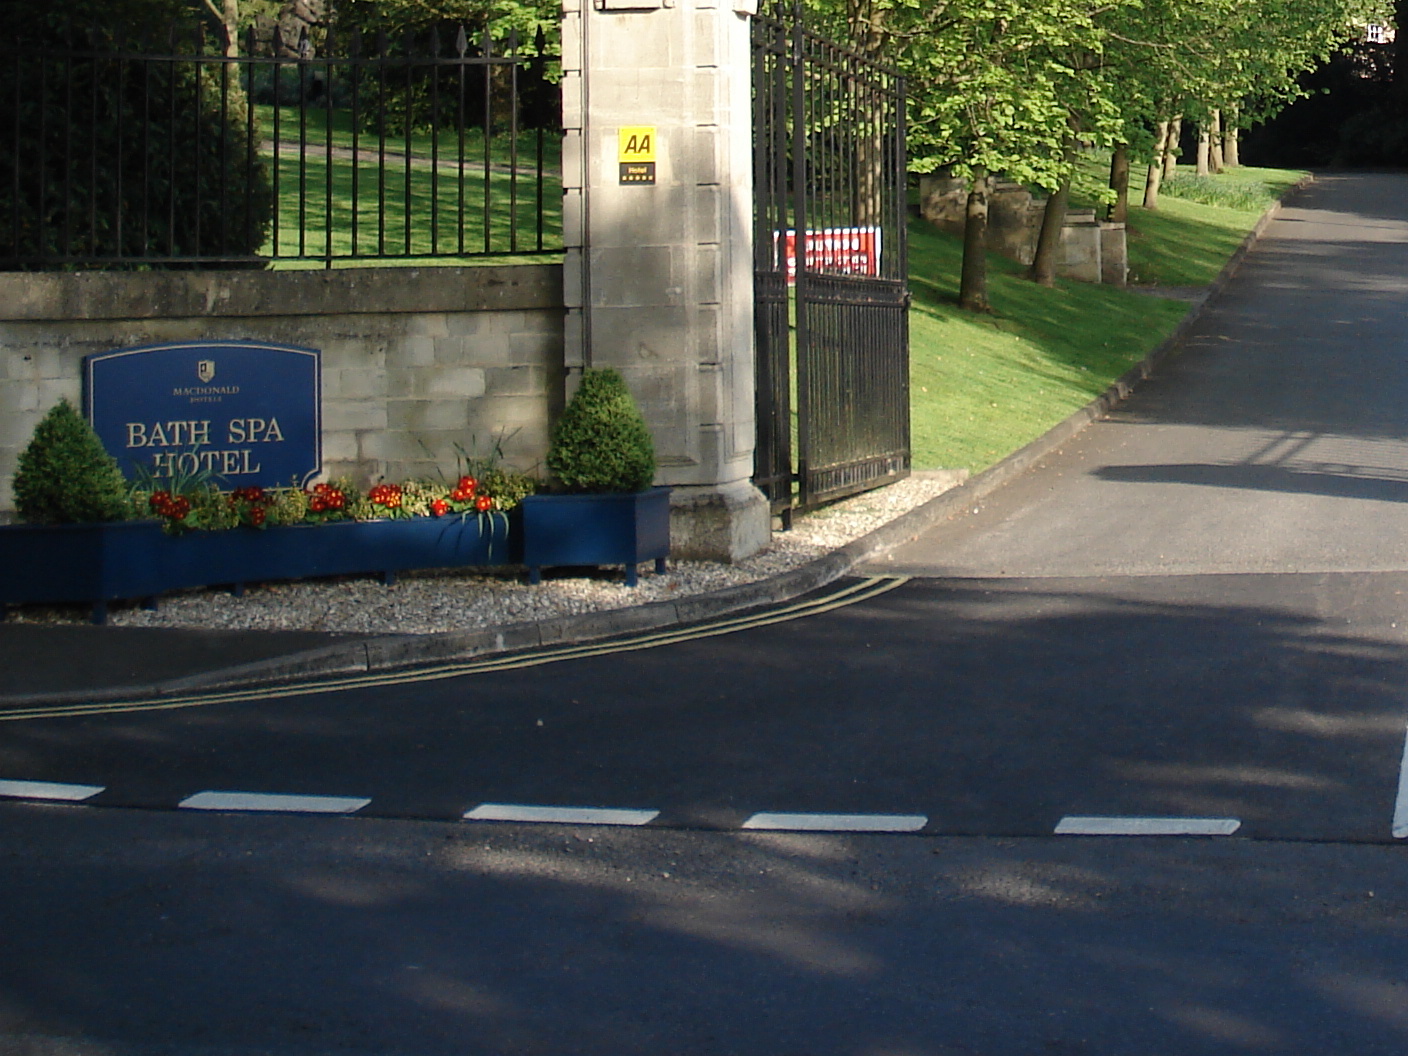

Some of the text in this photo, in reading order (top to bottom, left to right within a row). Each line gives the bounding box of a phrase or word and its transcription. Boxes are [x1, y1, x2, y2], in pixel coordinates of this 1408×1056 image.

[624, 134, 651, 154] AA
[628, 166, 648, 174] Hotel
[173, 386, 240, 396] MACDONALD
[126, 417, 285, 448] BATH SPA
[152, 450, 261, 479] HOTEL
